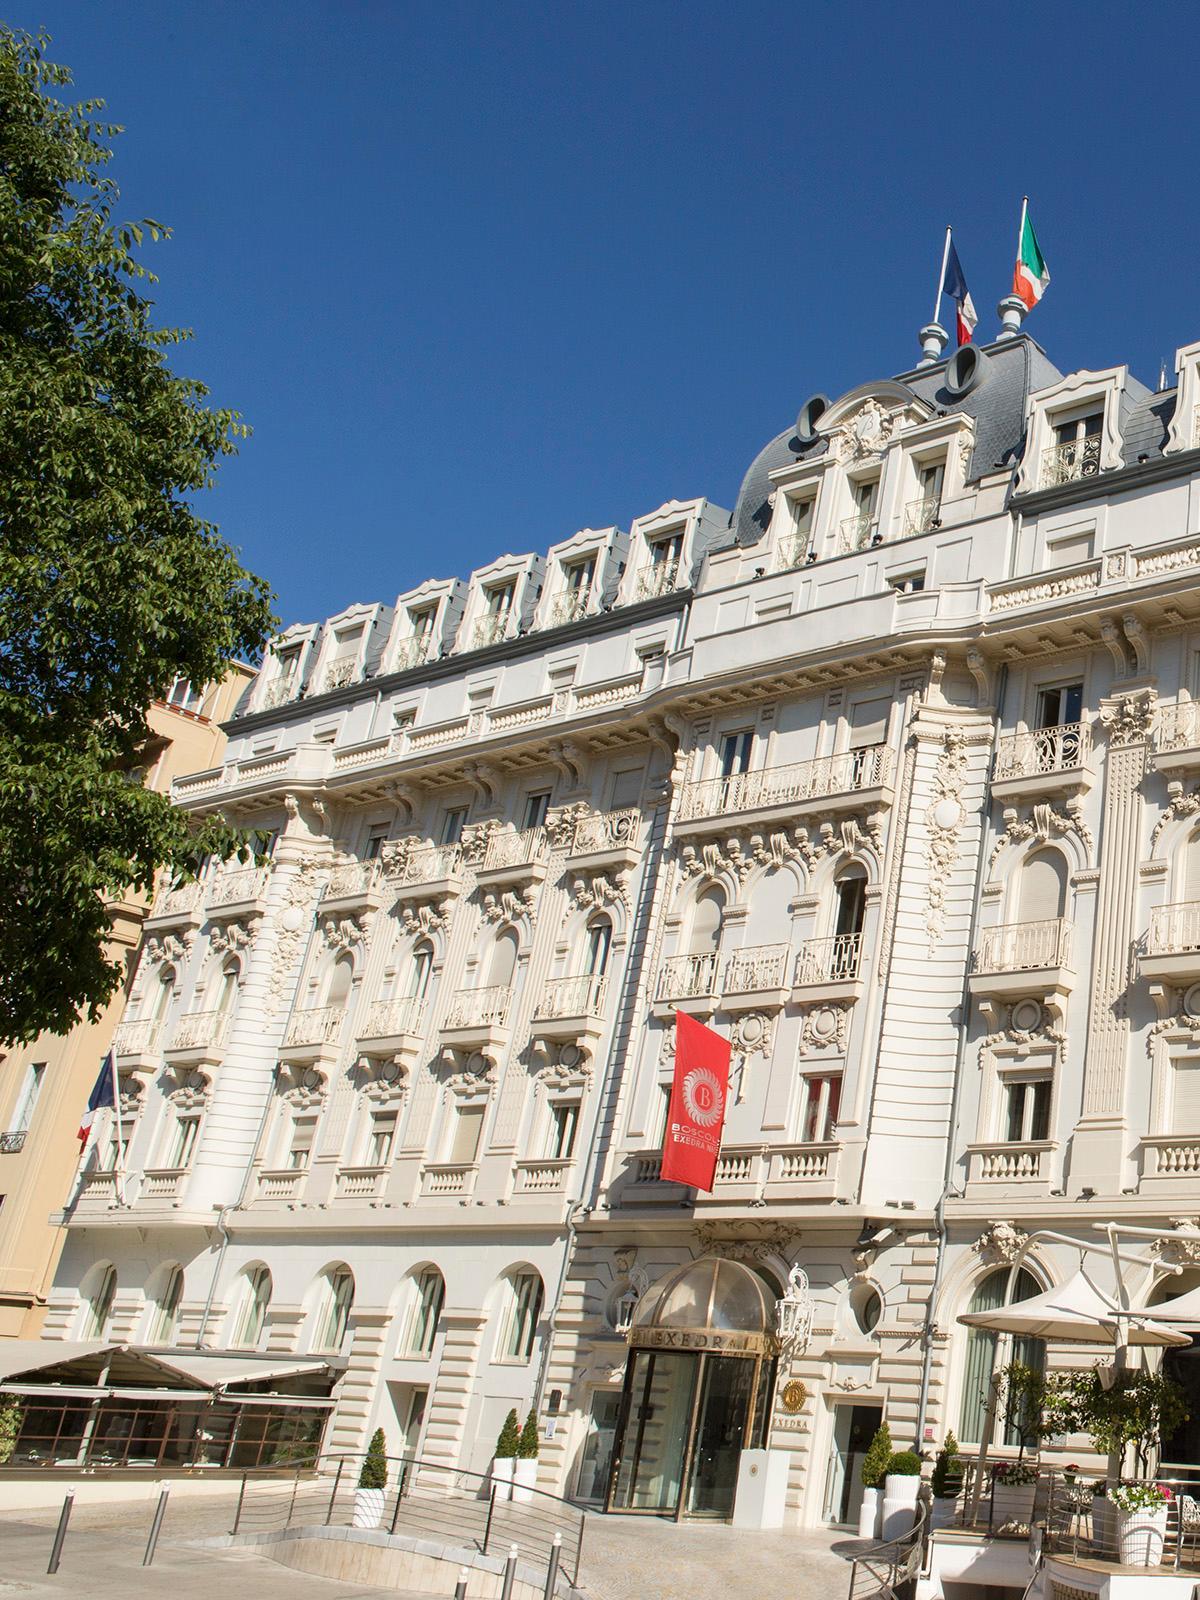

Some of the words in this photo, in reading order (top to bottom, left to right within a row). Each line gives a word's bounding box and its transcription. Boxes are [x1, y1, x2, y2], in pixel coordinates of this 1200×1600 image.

[701, 1086, 711, 1106] B
[674, 1134, 705, 1149] EXEDRA
[651, 1331, 736, 1348] EXEDRA
[772, 1417, 807, 1428] EXEDRA
